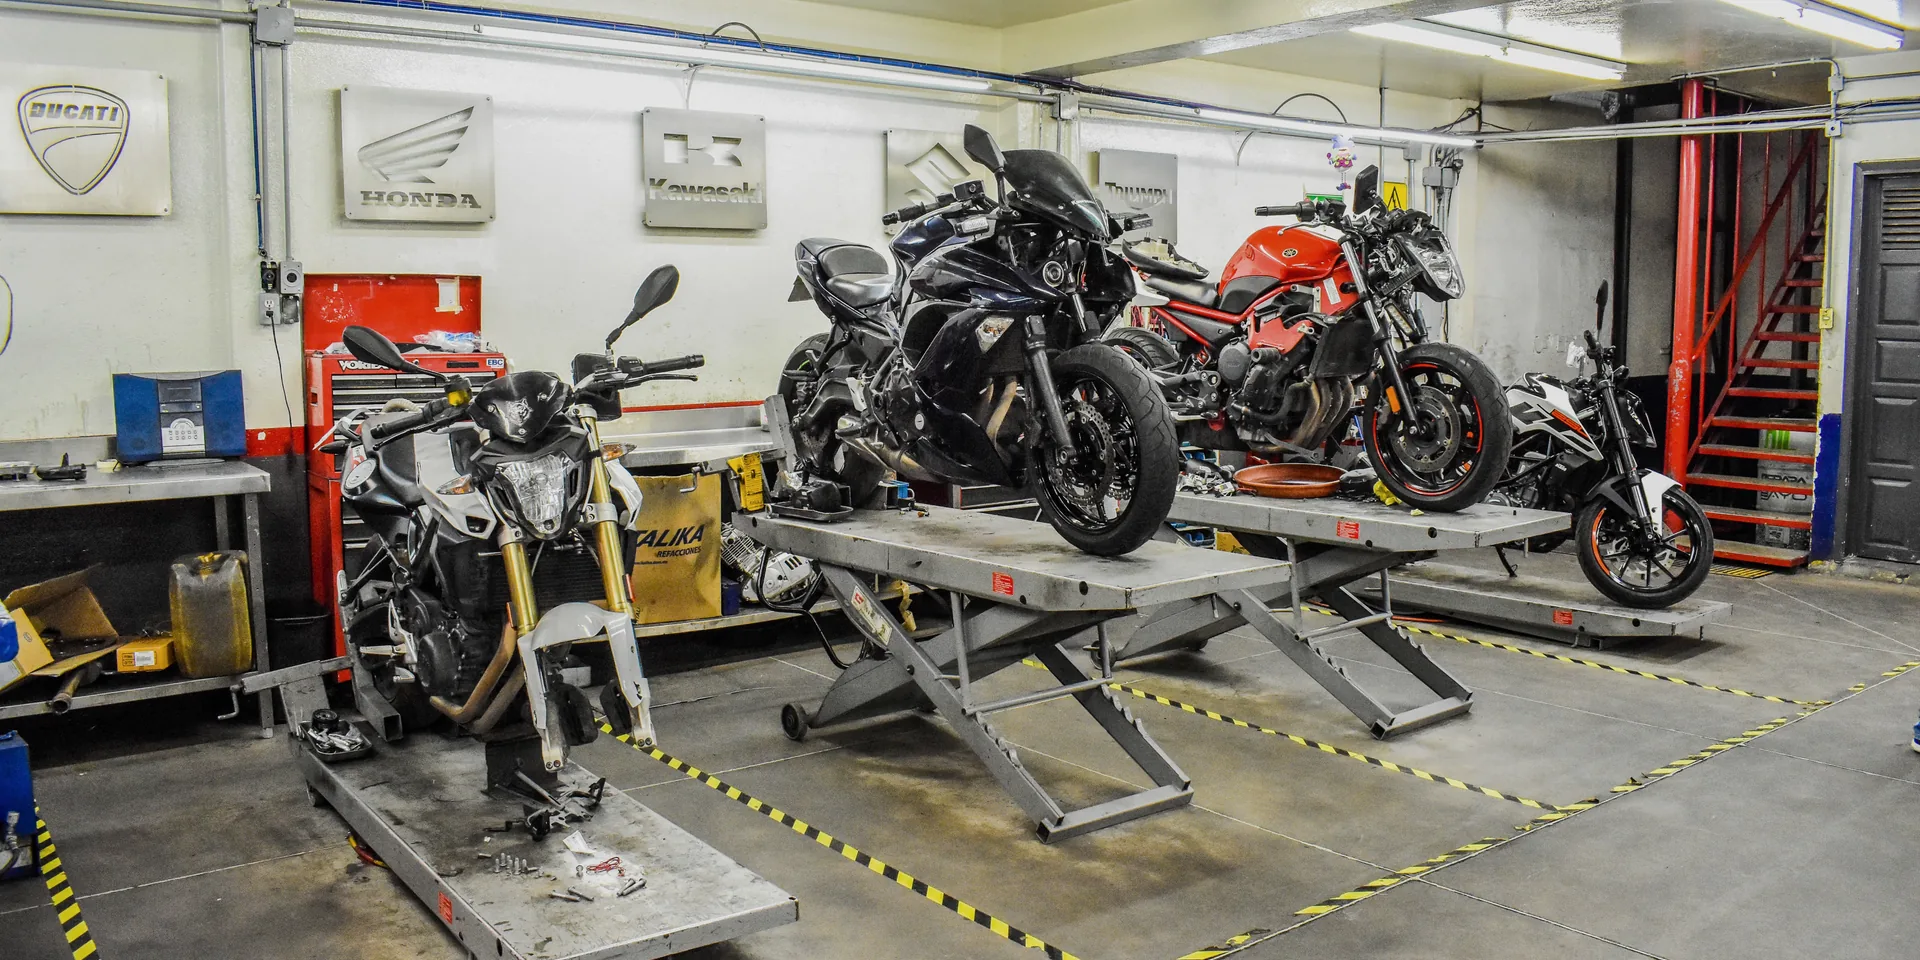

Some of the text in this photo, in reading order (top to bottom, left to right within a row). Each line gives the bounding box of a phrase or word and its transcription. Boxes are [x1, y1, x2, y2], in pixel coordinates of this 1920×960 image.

[29, 102, 119, 121] DUCATI
[360, 190, 482, 208] HONDA
[649, 178, 762, 203] Kawasaki
[1104, 182, 1173, 205] TRIUMPH
[657, 546, 702, 557] REFACCIONES
